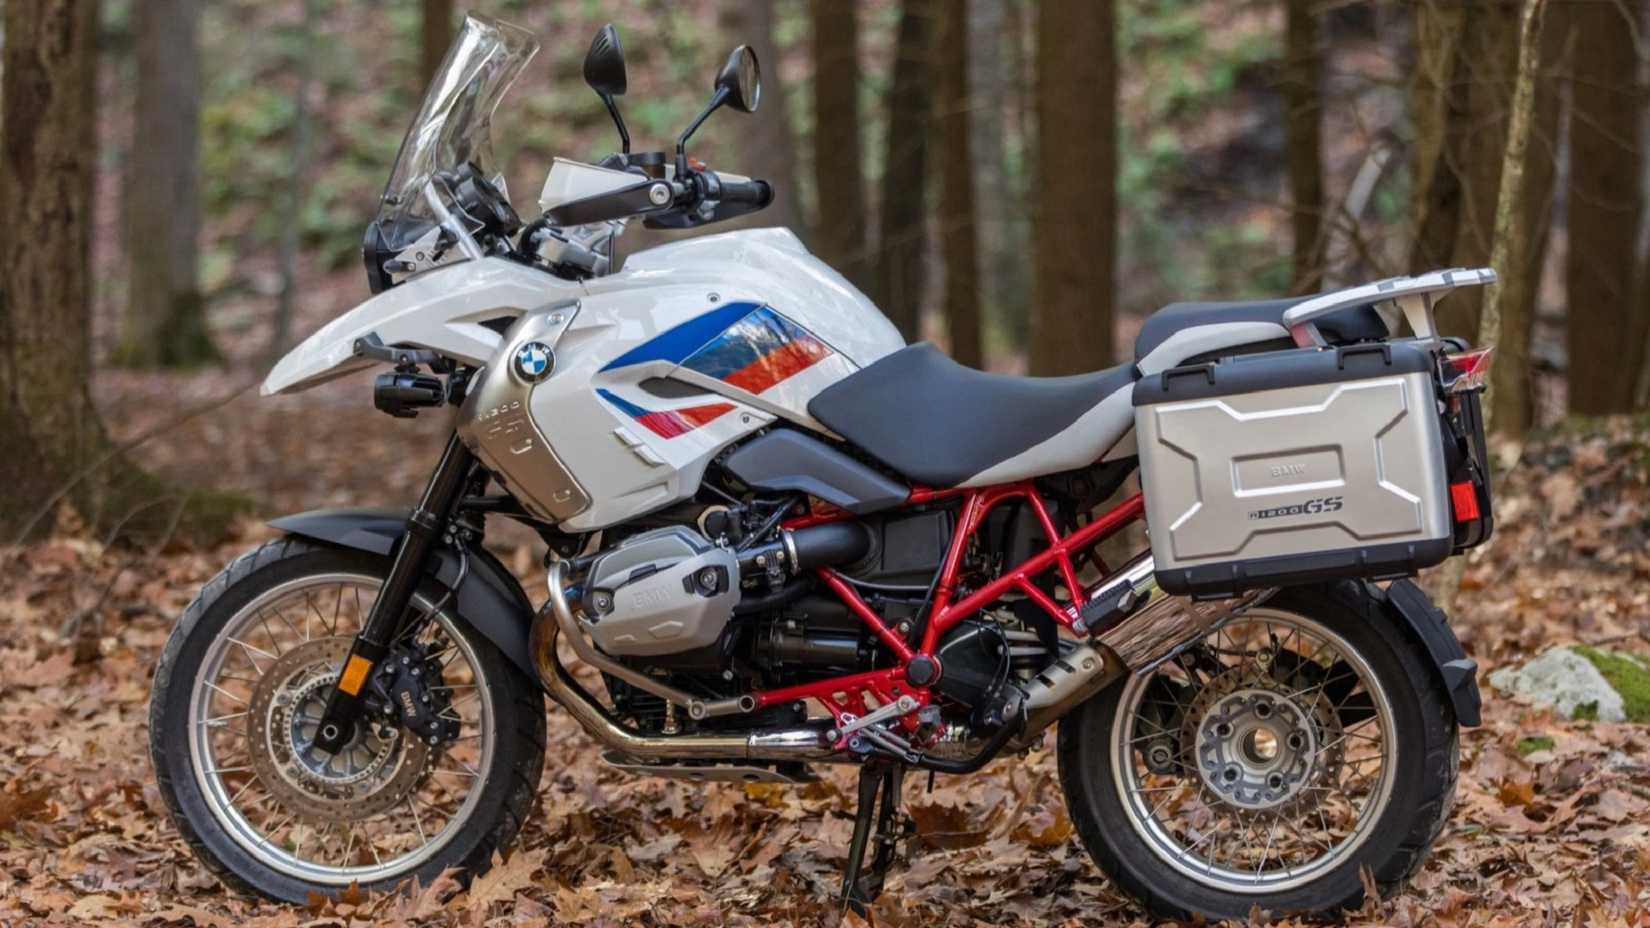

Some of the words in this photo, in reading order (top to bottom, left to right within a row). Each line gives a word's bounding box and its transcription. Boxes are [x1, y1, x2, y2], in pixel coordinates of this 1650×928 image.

[518, 343, 551, 357] BMW
[1270, 463, 1305, 478] BMW
[632, 584, 672, 609] BMW
[400, 690, 417, 717] BMW
